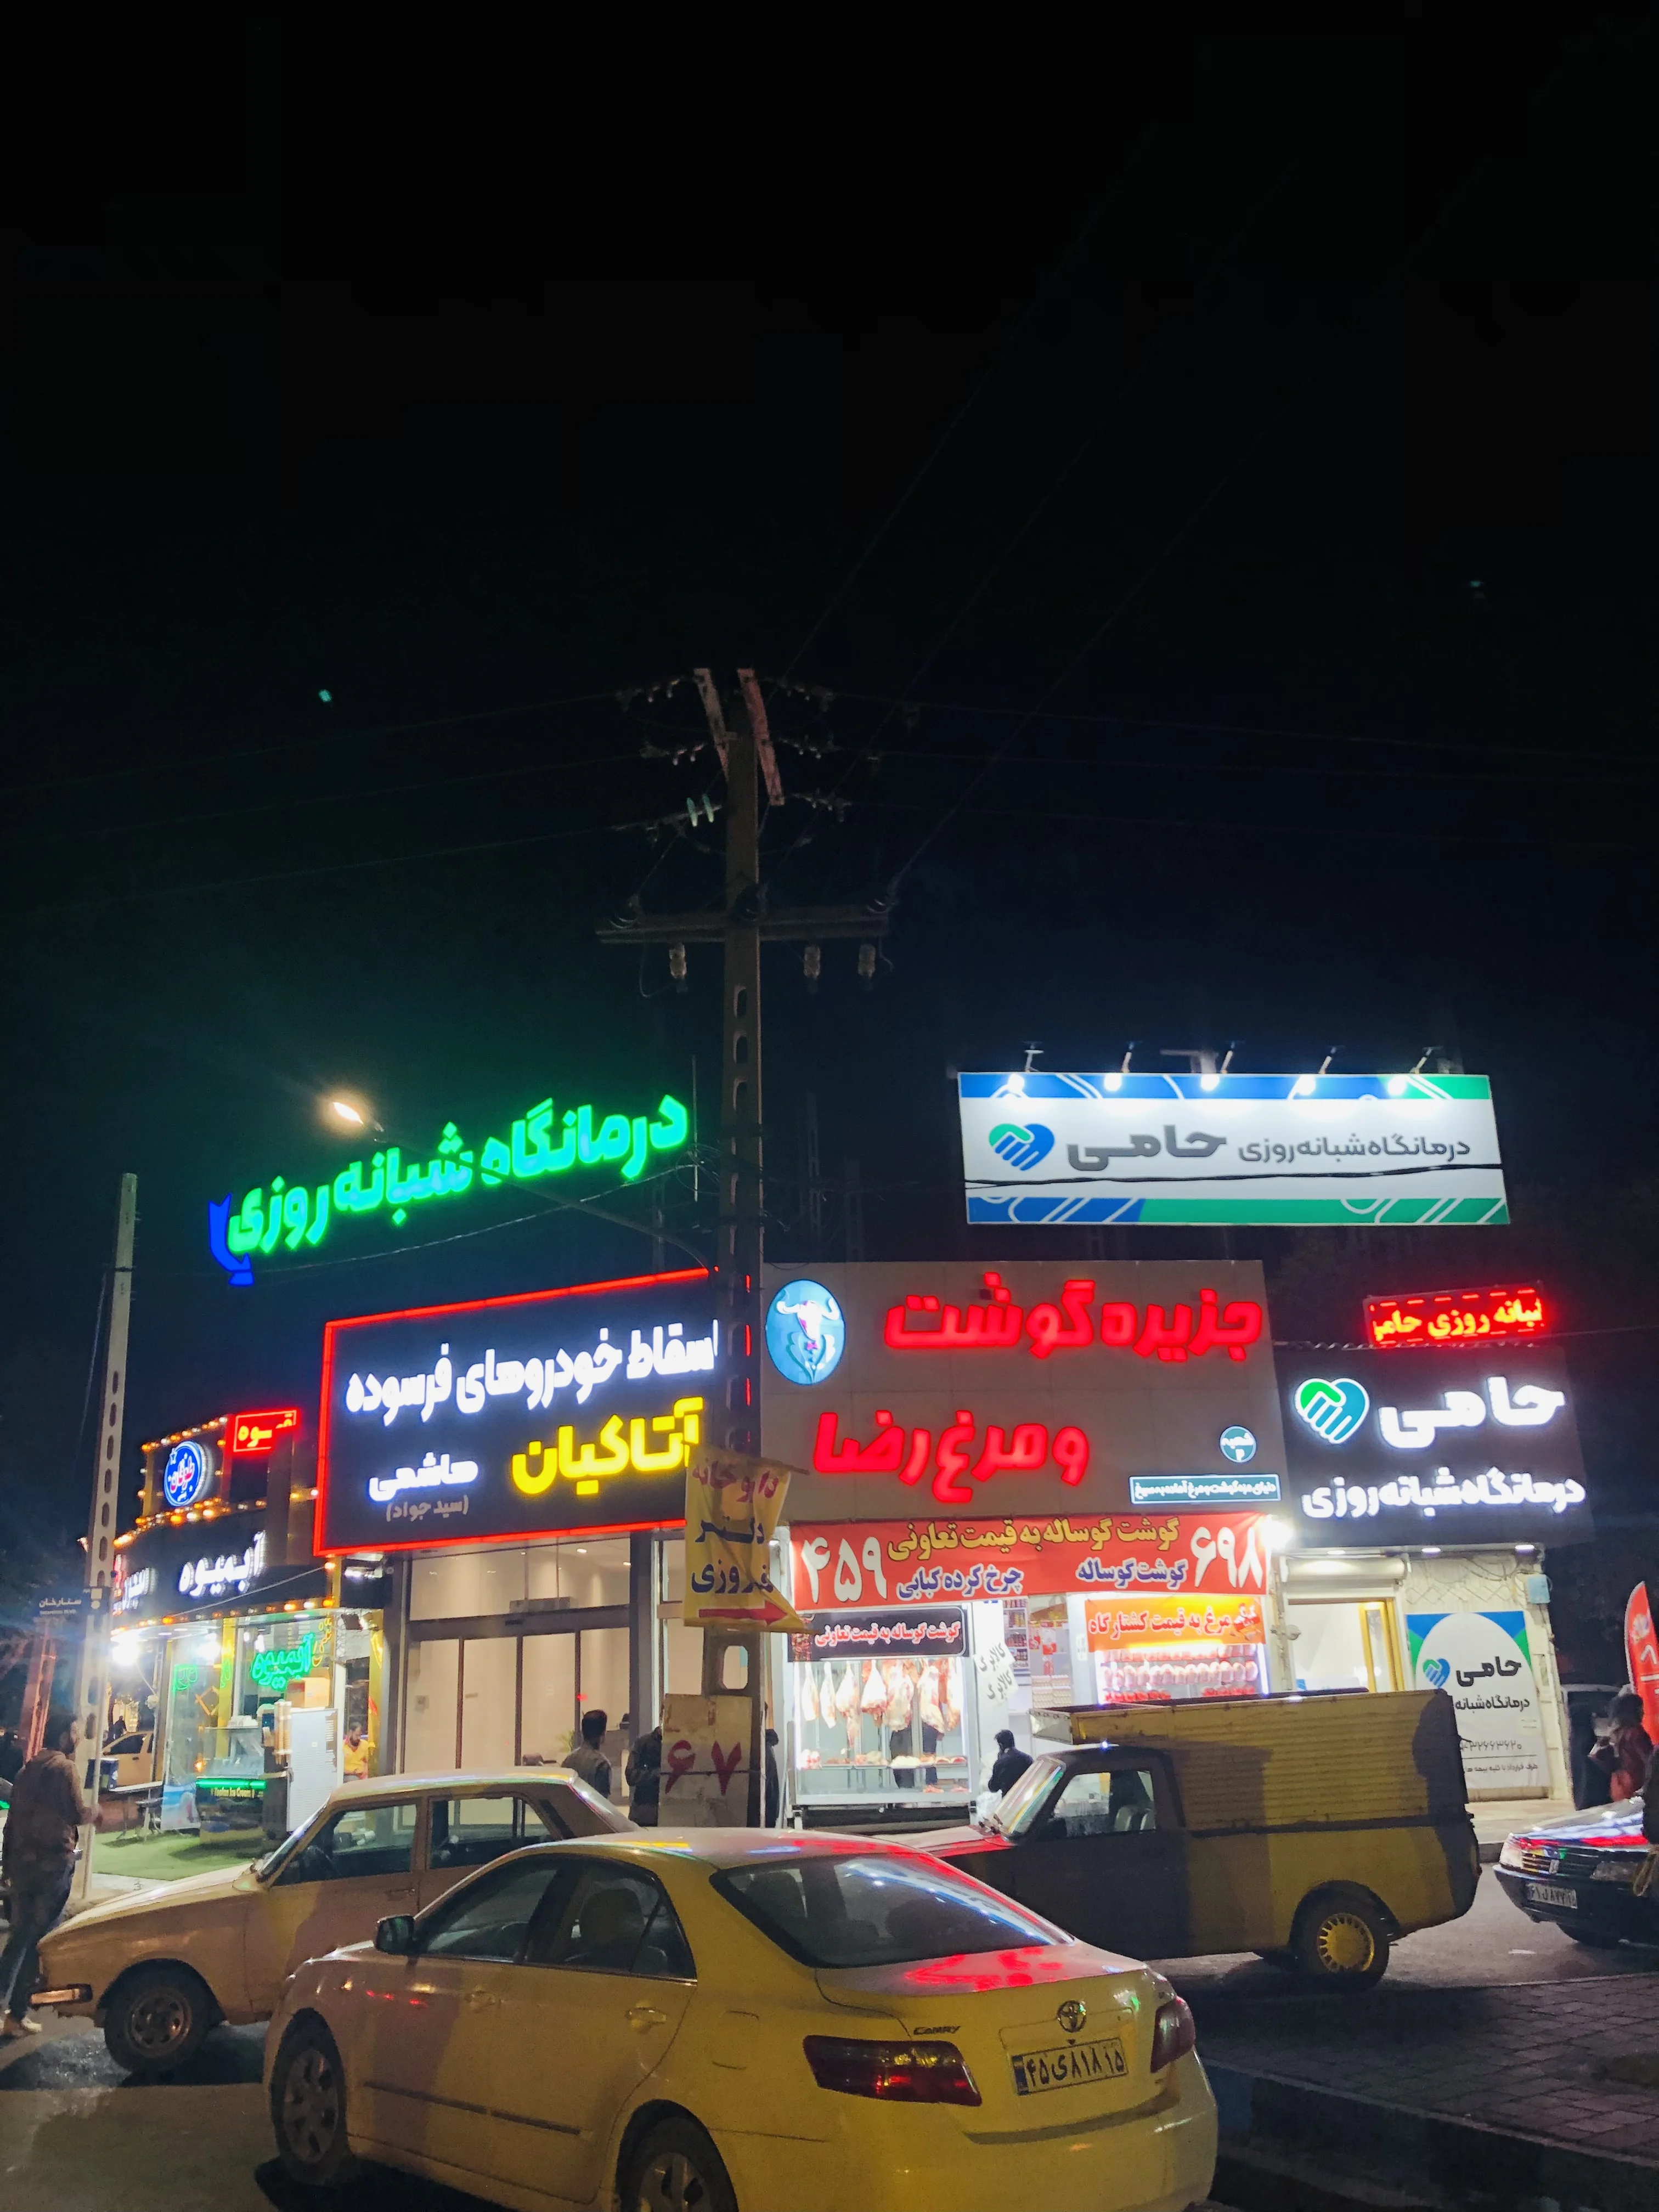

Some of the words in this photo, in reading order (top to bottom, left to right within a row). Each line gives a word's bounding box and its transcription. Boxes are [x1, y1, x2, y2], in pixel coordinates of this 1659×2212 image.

[481, 1094, 689, 1185] درمانگاه
[1067, 1125, 1227, 1171] حامی
[1238, 1137, 1297, 1163] روزی
[1298, 1133, 1367, 1164] شبانه
[1369, 1133, 1470, 1161] درمانگاه
[334, 1122, 474, 1226] شبانه
[228, 1176, 330, 1253] روزی
[883, 1272, 1096, 1359] گوشت
[1101, 1289, 1263, 1362] جزیره
[1428, 1309, 1491, 1337] روزی
[456, 1327, 624, 1413] خودروهای
[625, 1319, 719, 1380] اسقاط
[346, 1342, 453, 1426] فرسوده
[1378, 1376, 1565, 1449] حامی
[814, 1411, 932, 1487] رضا
[933, 1410, 1049, 1503] مرغ
[1052, 1426, 1090, 1486] و
[369, 1452, 478, 1501] هاشمی
[1301, 1476, 1379, 1517] روزی
[1379, 1466, 1464, 1516] شبانه
[1462, 1467, 1587, 1513] درمانگاه
[887, 1521, 961, 1562] تعاونی
[960, 1519, 1018, 1554] قیمت
[1019, 1524, 1043, 1552] به
[1043, 1517, 1113, 1551] گوساله
[1116, 1517, 1180, 1551] گوشت
[1190, 1526, 1263, 1588] ۶۹۸
[178, 1530, 267, 1597] آبمیوه
[801, 1536, 888, 1603] ۴۵۹
[896, 1566, 943, 1601] کبابی
[984, 1564, 1024, 1595] چرخ
[1075, 1556, 1136, 1589] گوساله
[1136, 1558, 1188, 1590] گوشت
[1204, 1606, 1232, 1635] مرغ
[1456, 1656, 1522, 1687] حامی
[1455, 1694, 1486, 1714] شبانه
[1485, 1694, 1531, 1712] درمانگاه
